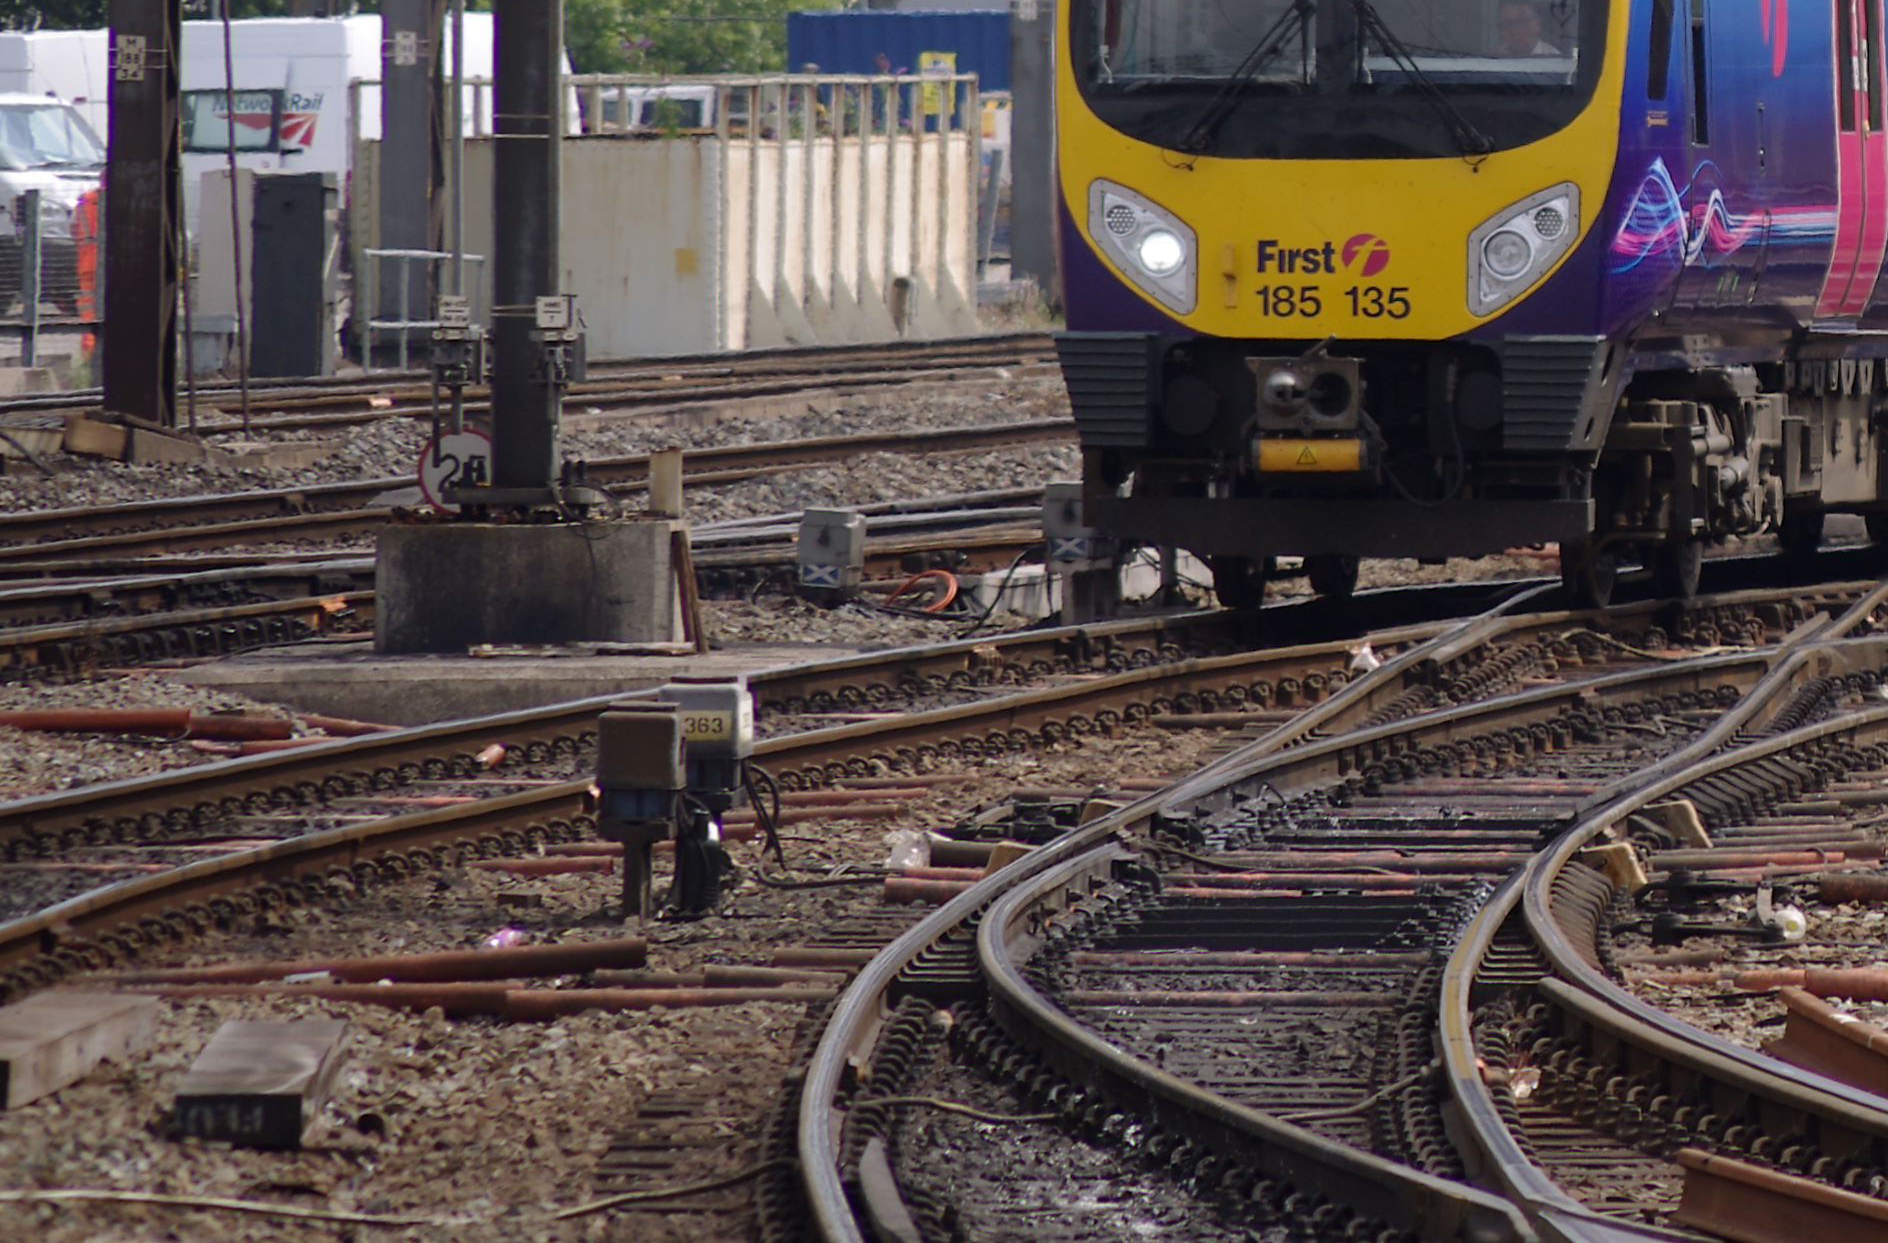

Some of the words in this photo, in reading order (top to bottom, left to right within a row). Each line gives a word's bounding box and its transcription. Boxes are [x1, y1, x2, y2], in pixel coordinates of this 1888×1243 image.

[126, 37, 137, 48] M
[1257, 239, 1336, 274] First
[1256, 285, 1322, 318] 185
[1344, 286, 1411, 319] 135
[684, 717, 723, 734] 363
